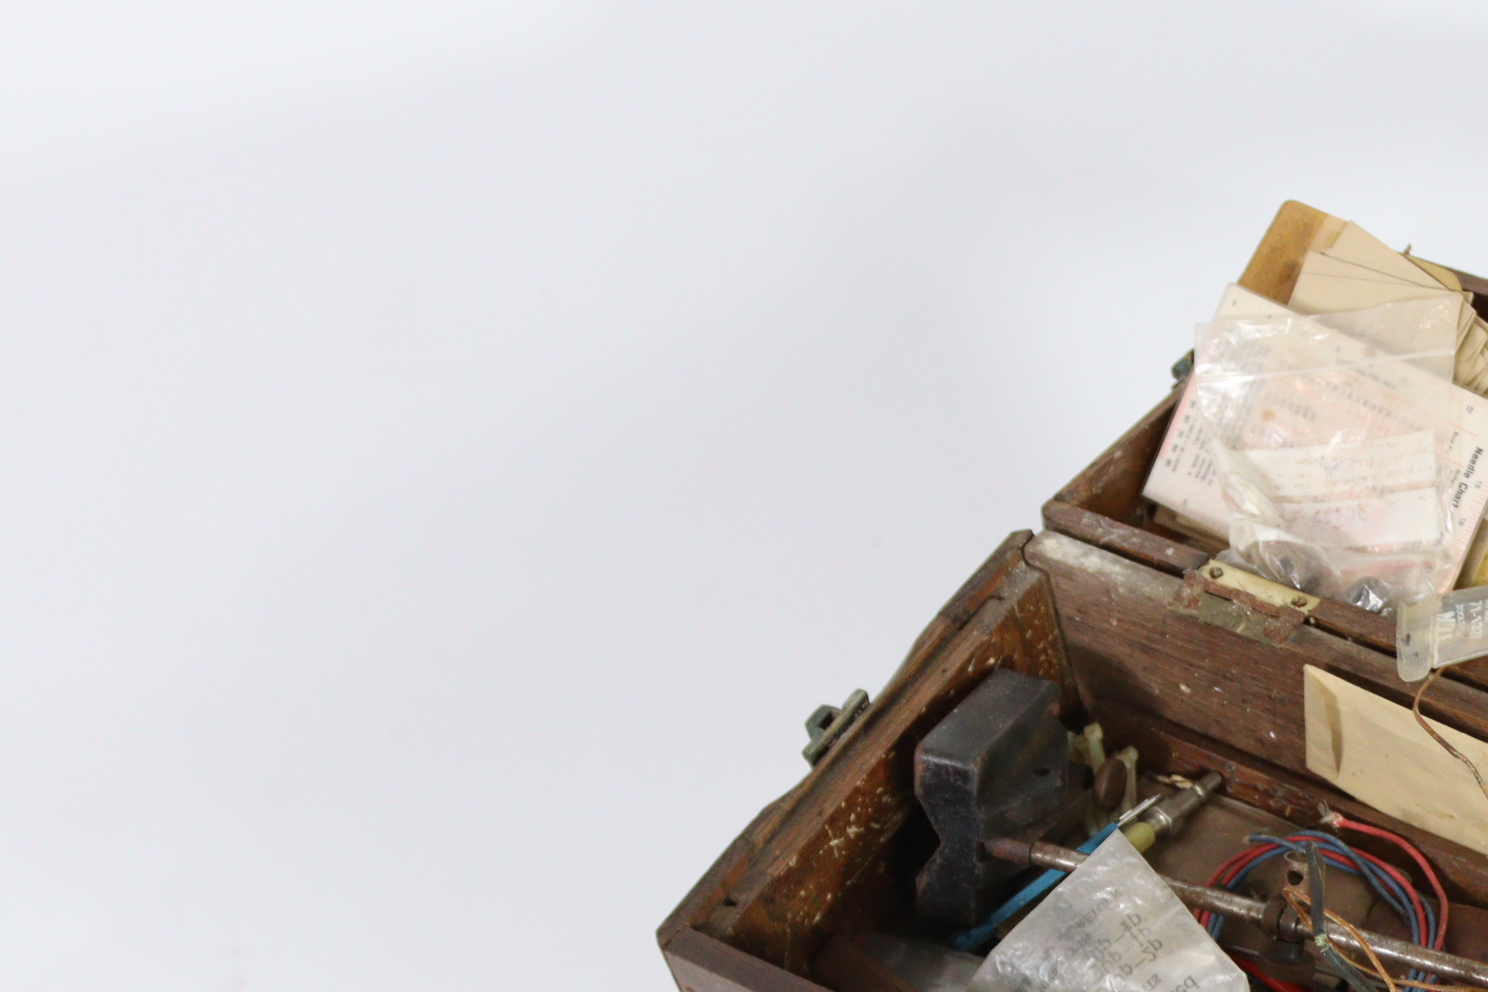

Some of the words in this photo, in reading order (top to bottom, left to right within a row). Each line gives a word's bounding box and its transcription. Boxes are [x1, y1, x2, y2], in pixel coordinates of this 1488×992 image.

[1463, 446, 1484, 480] Needle
[1474, 480, 1483, 489] 15
[1450, 481, 1469, 509] Chart
[1458, 517, 1466, 527] 16
